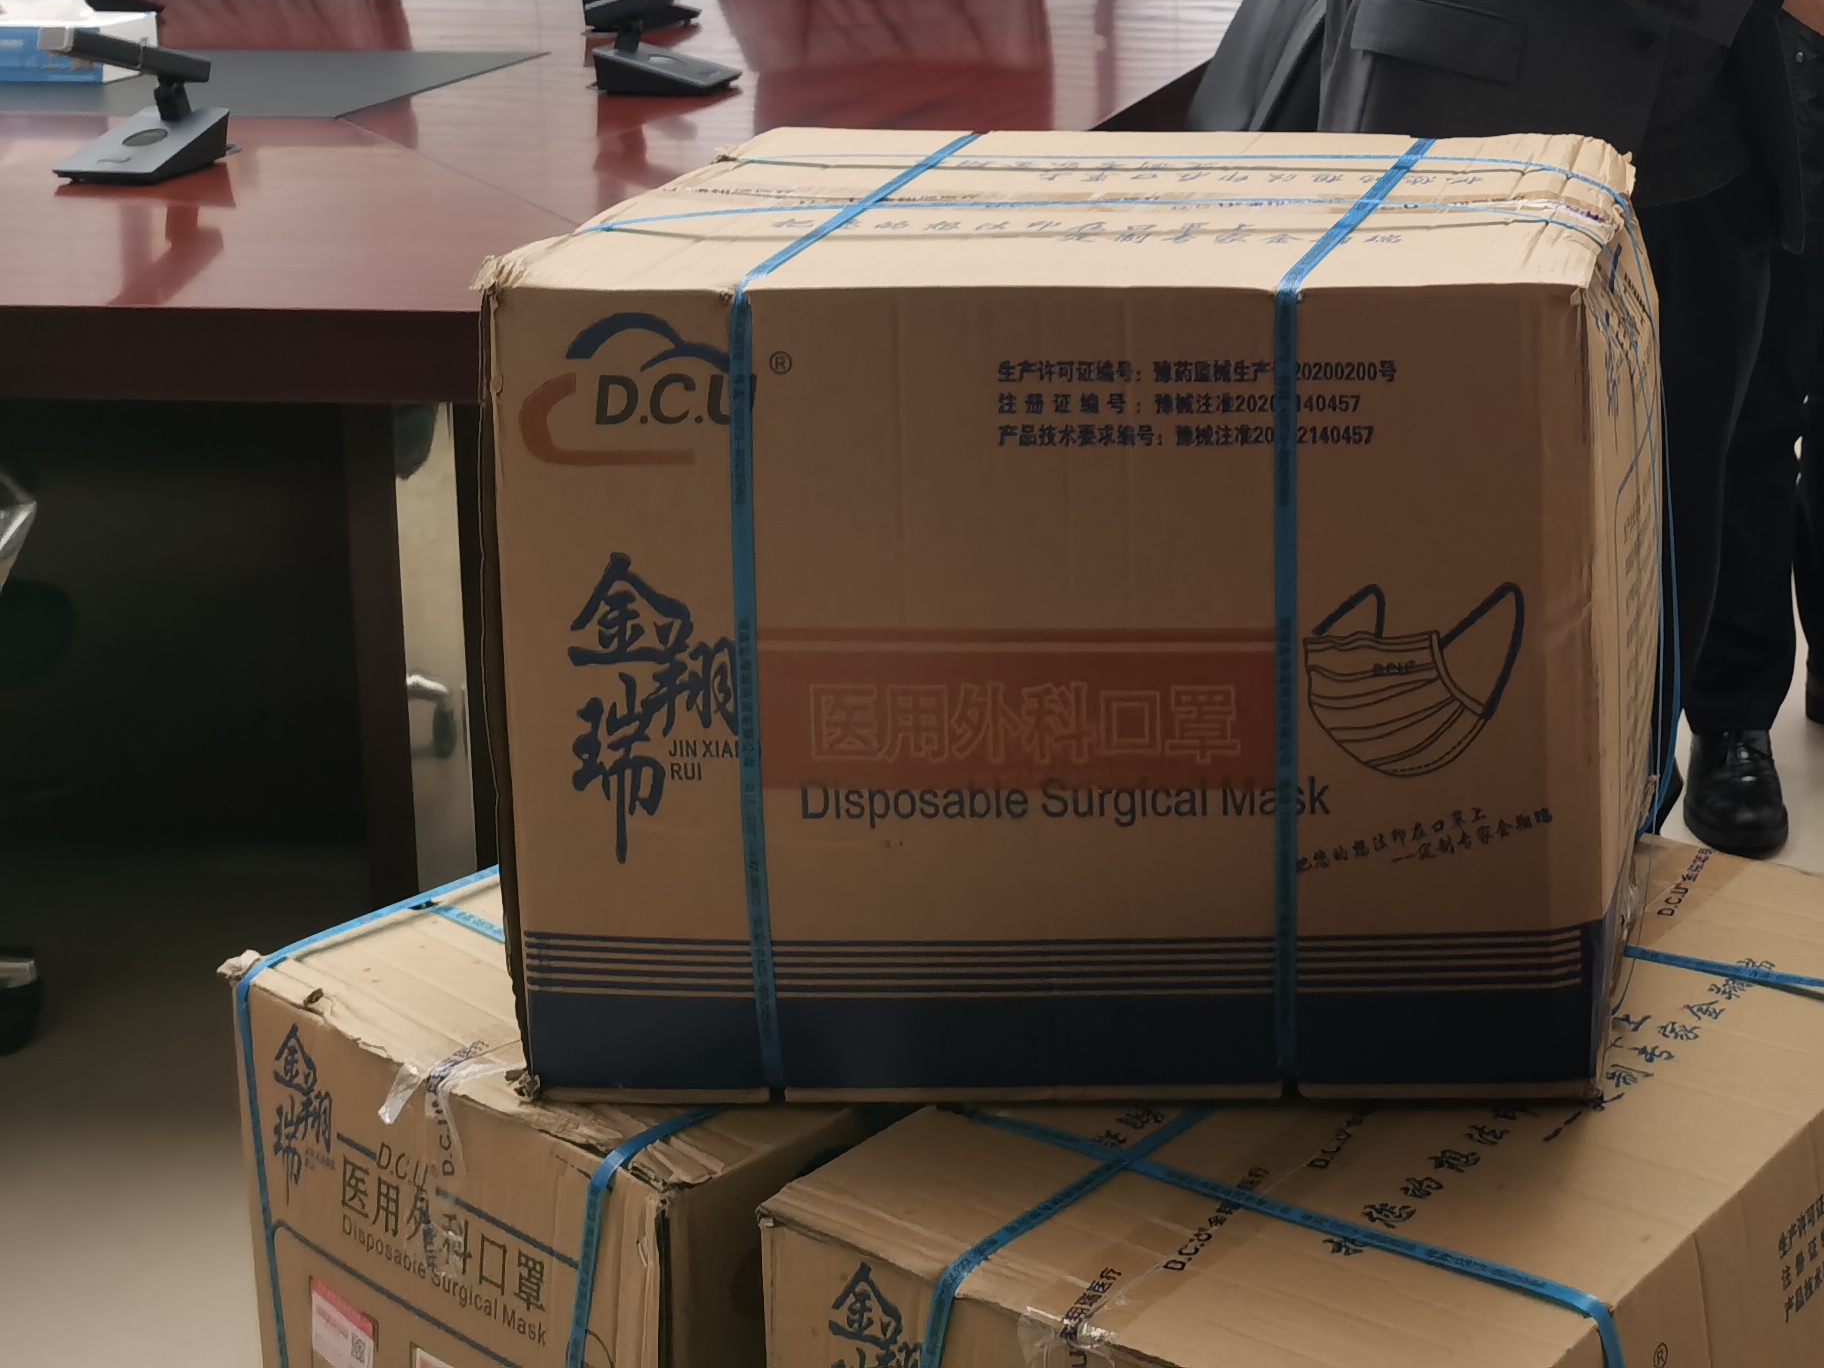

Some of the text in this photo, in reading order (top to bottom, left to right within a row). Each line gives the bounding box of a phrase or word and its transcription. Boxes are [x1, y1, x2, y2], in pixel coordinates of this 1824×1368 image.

[809, 681, 1242, 765] 医用外科口罩
[668, 739, 699, 759] JIN
[670, 762, 703, 781] RUI
[800, 777, 1029, 829] Disposable
[1041, 776, 1209, 828] Surgical
[502, 1304, 547, 1347] Mask
